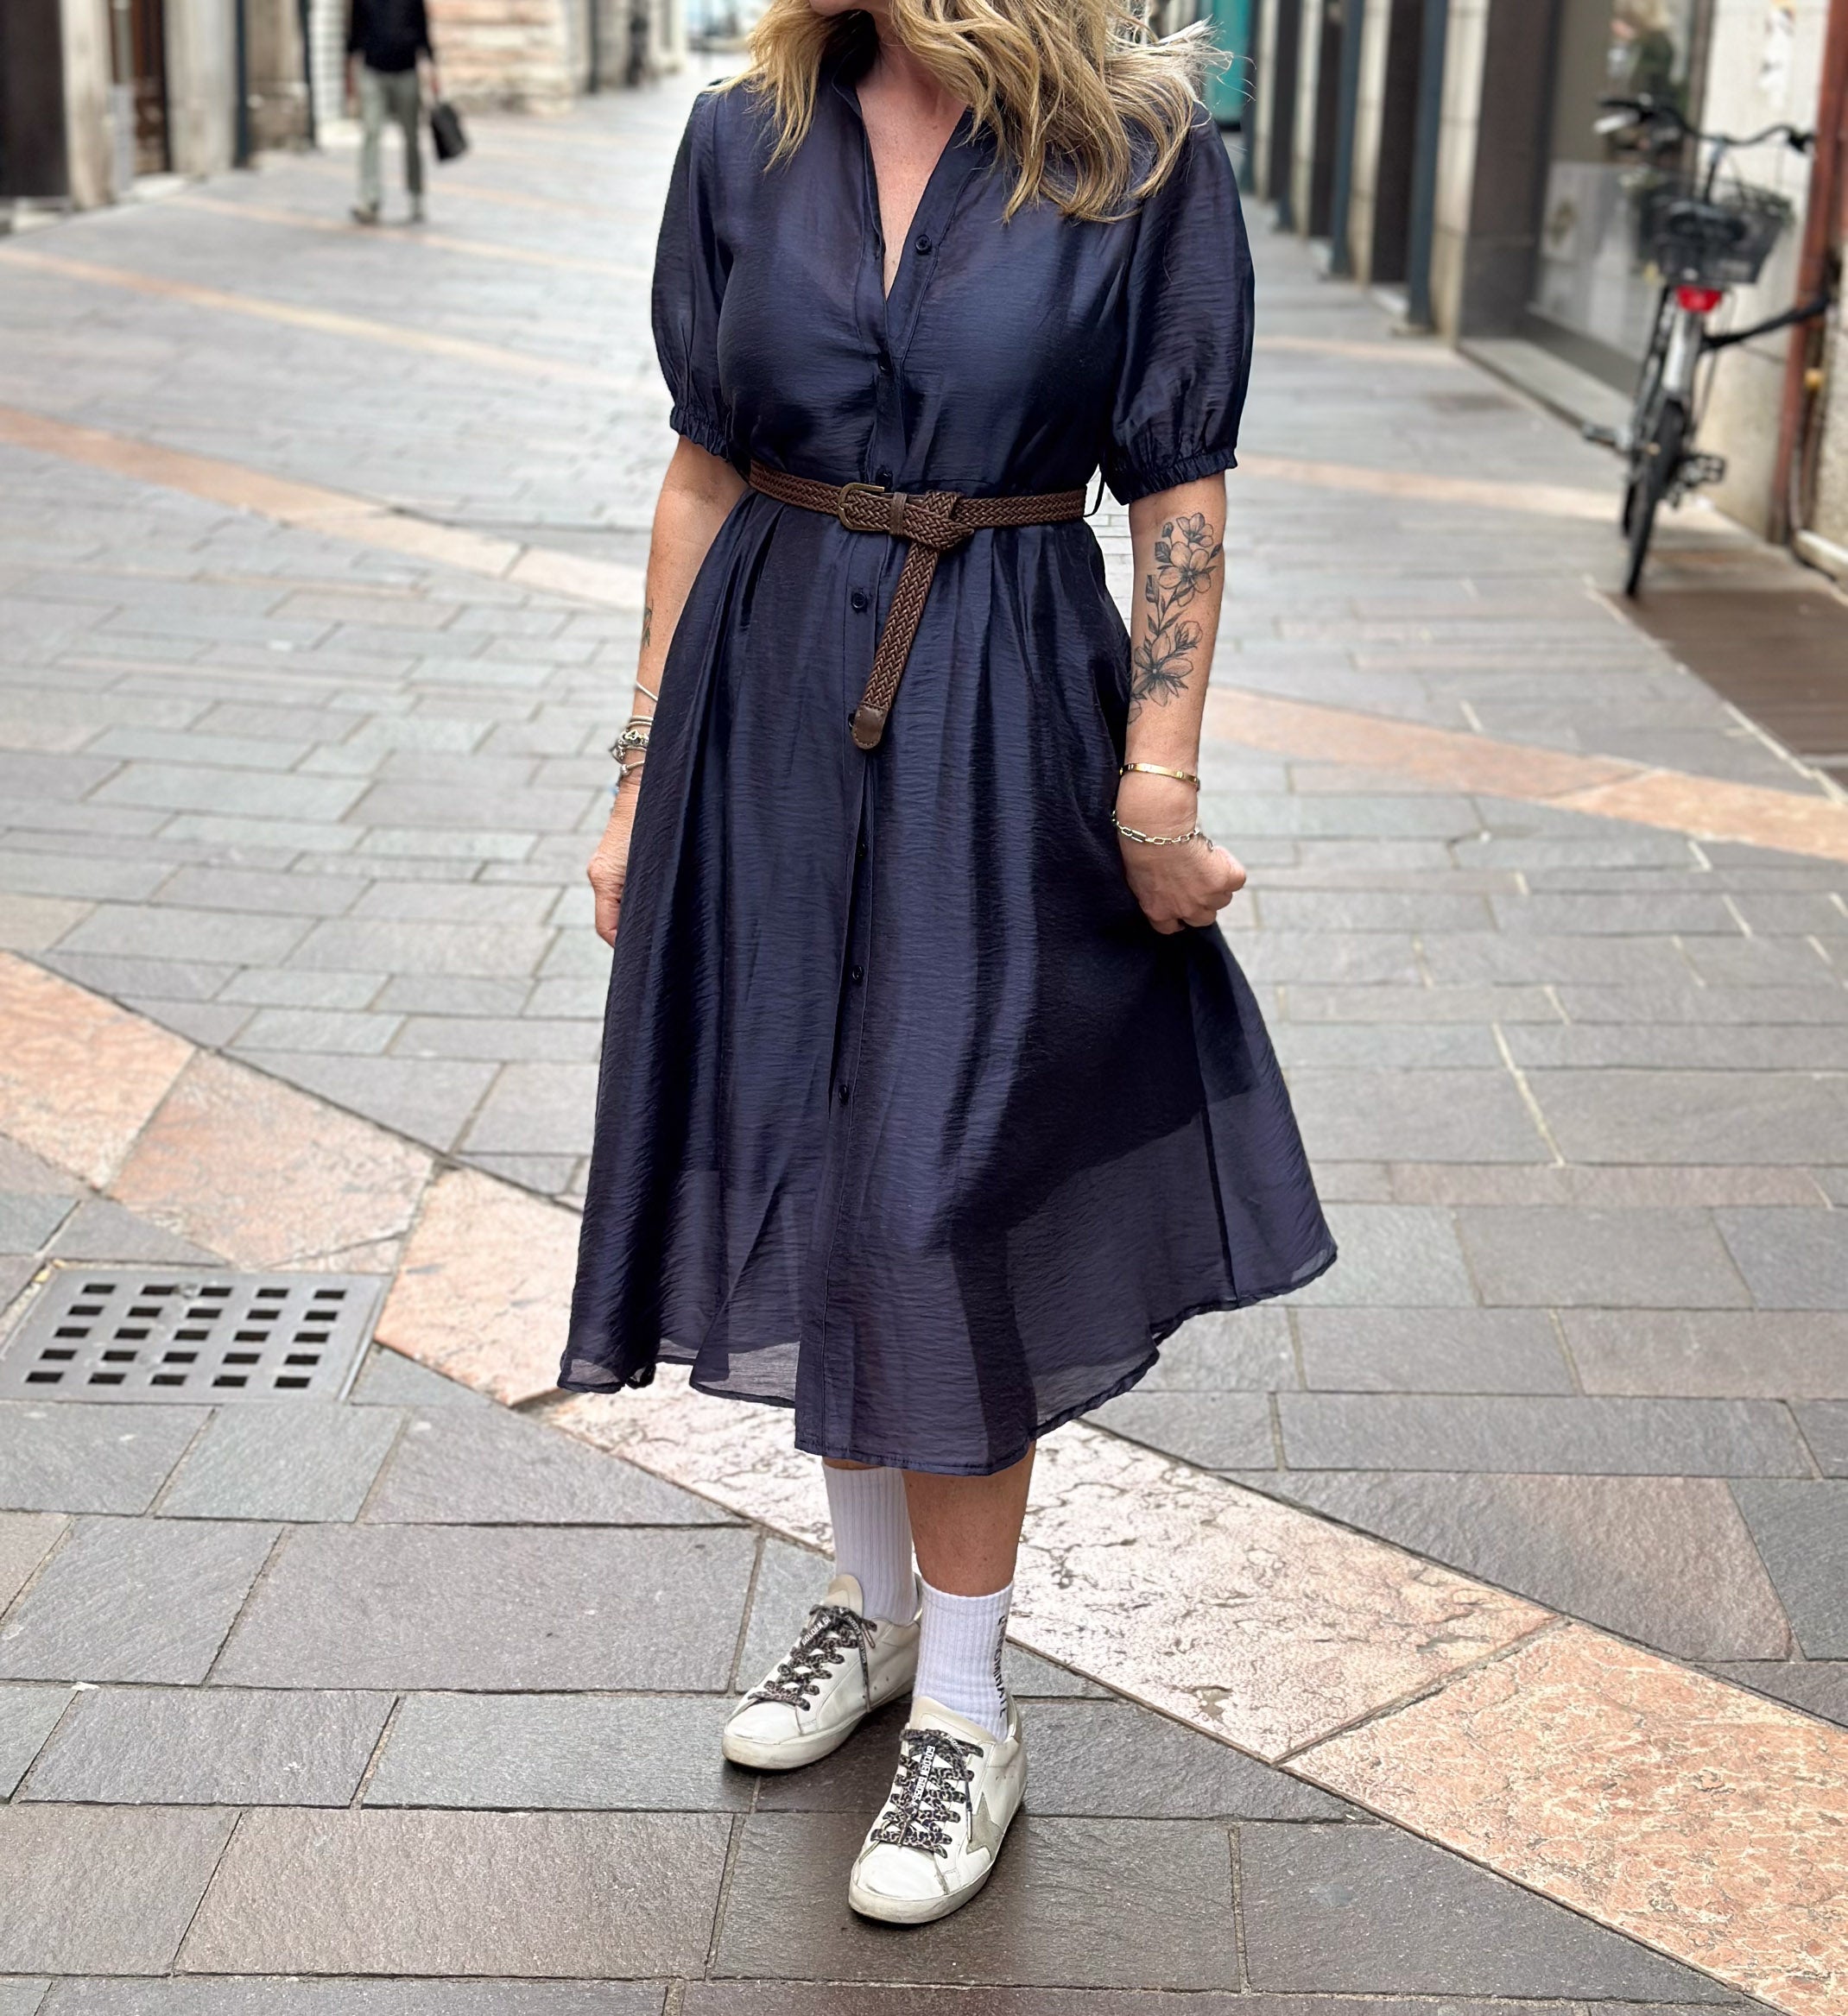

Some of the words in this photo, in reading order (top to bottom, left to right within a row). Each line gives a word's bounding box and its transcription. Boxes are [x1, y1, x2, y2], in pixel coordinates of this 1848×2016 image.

[801, 1621, 823, 1646] GOLDEN
[921, 1745, 936, 1777] GOLDEN
[912, 1777, 928, 1801] GOOSE
